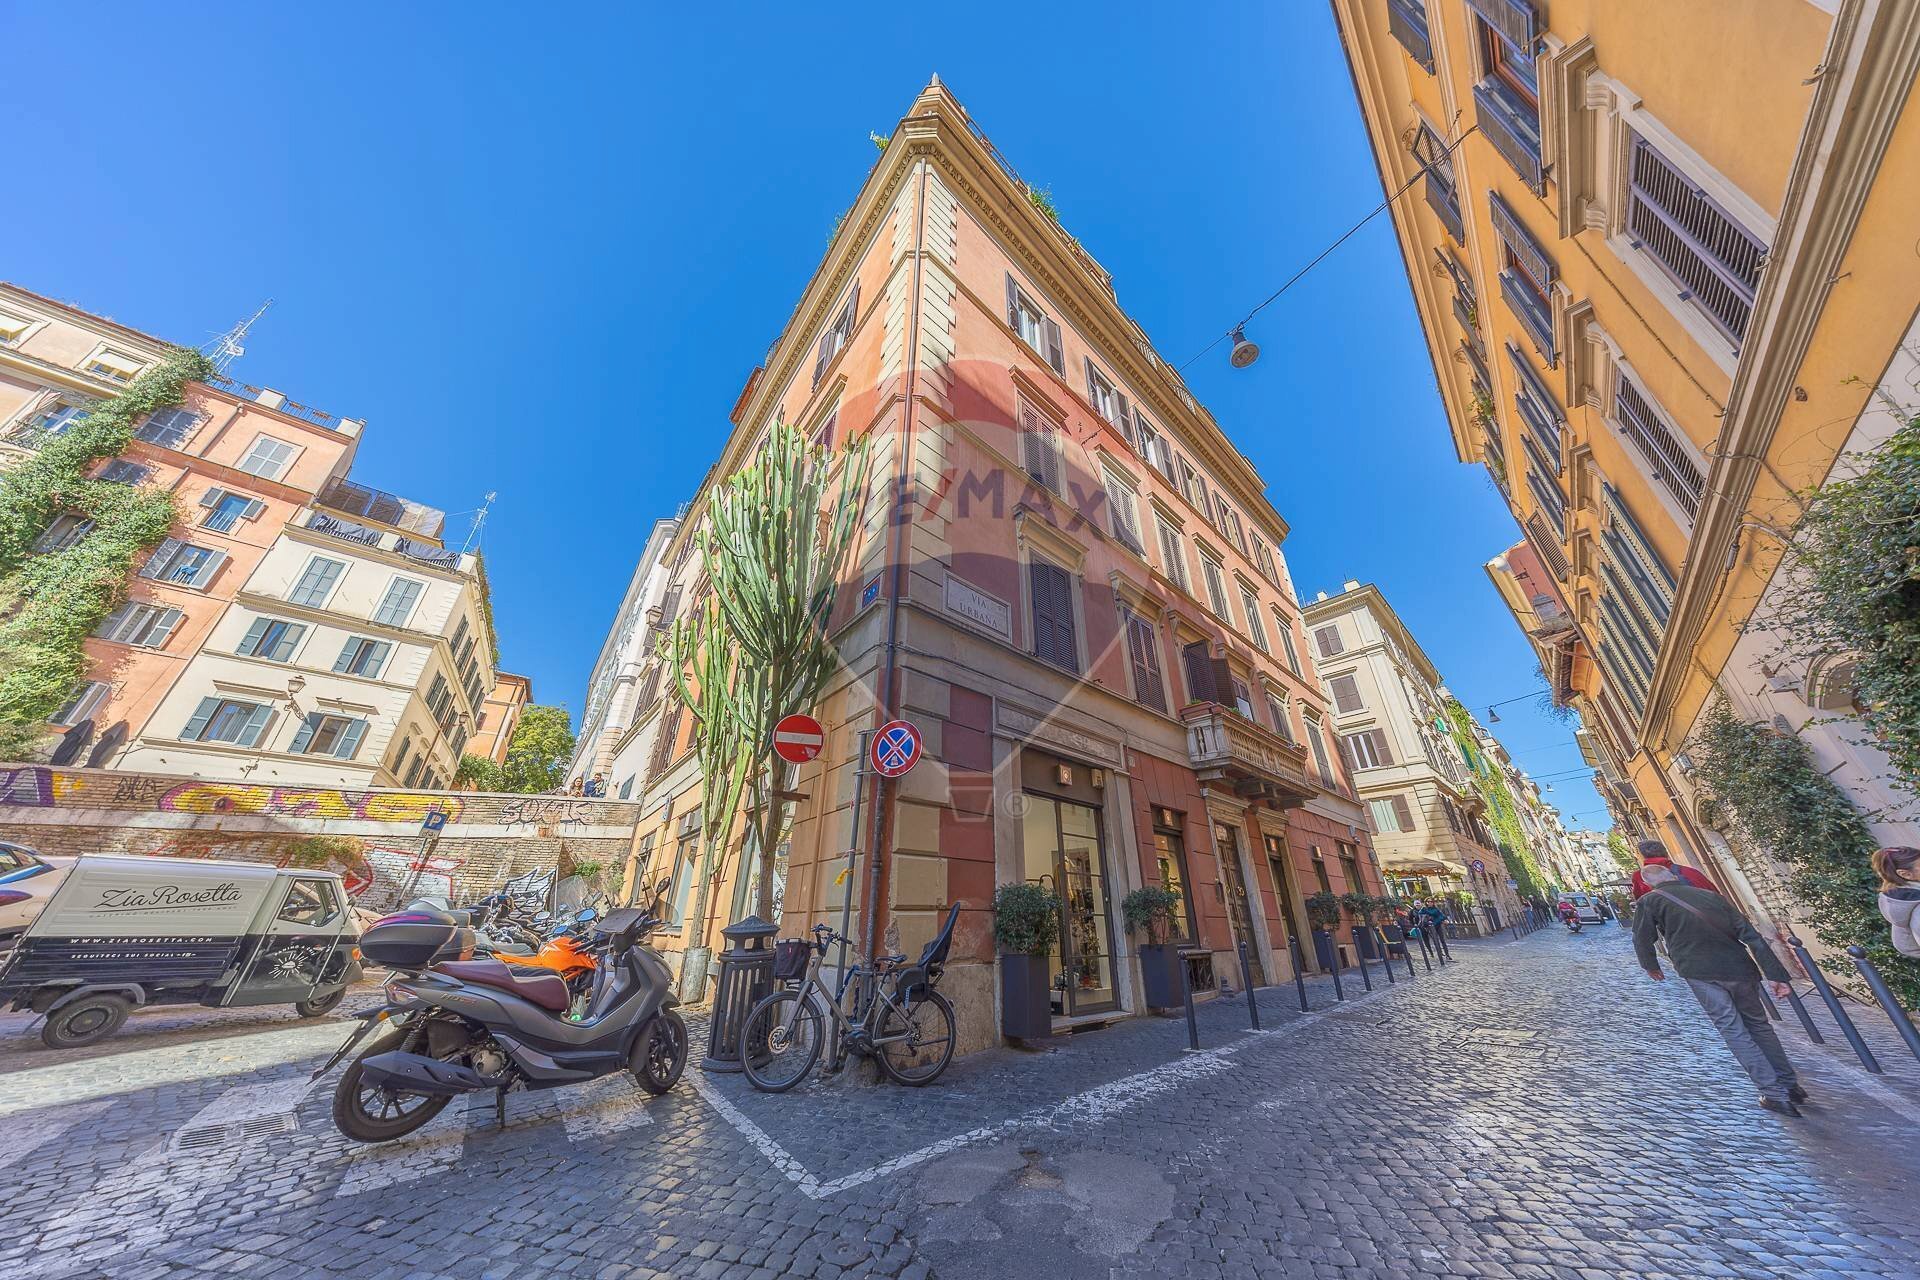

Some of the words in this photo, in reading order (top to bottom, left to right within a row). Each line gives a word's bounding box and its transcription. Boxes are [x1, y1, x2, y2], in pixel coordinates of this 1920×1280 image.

[971, 593, 987, 609] VIA
[960, 602, 997, 628] URBANA
[93, 888, 149, 909] Zia
[148, 882, 243, 906] Rosetta
[70, 937, 213, 945] WWW.ZIAROSETTA.COM
